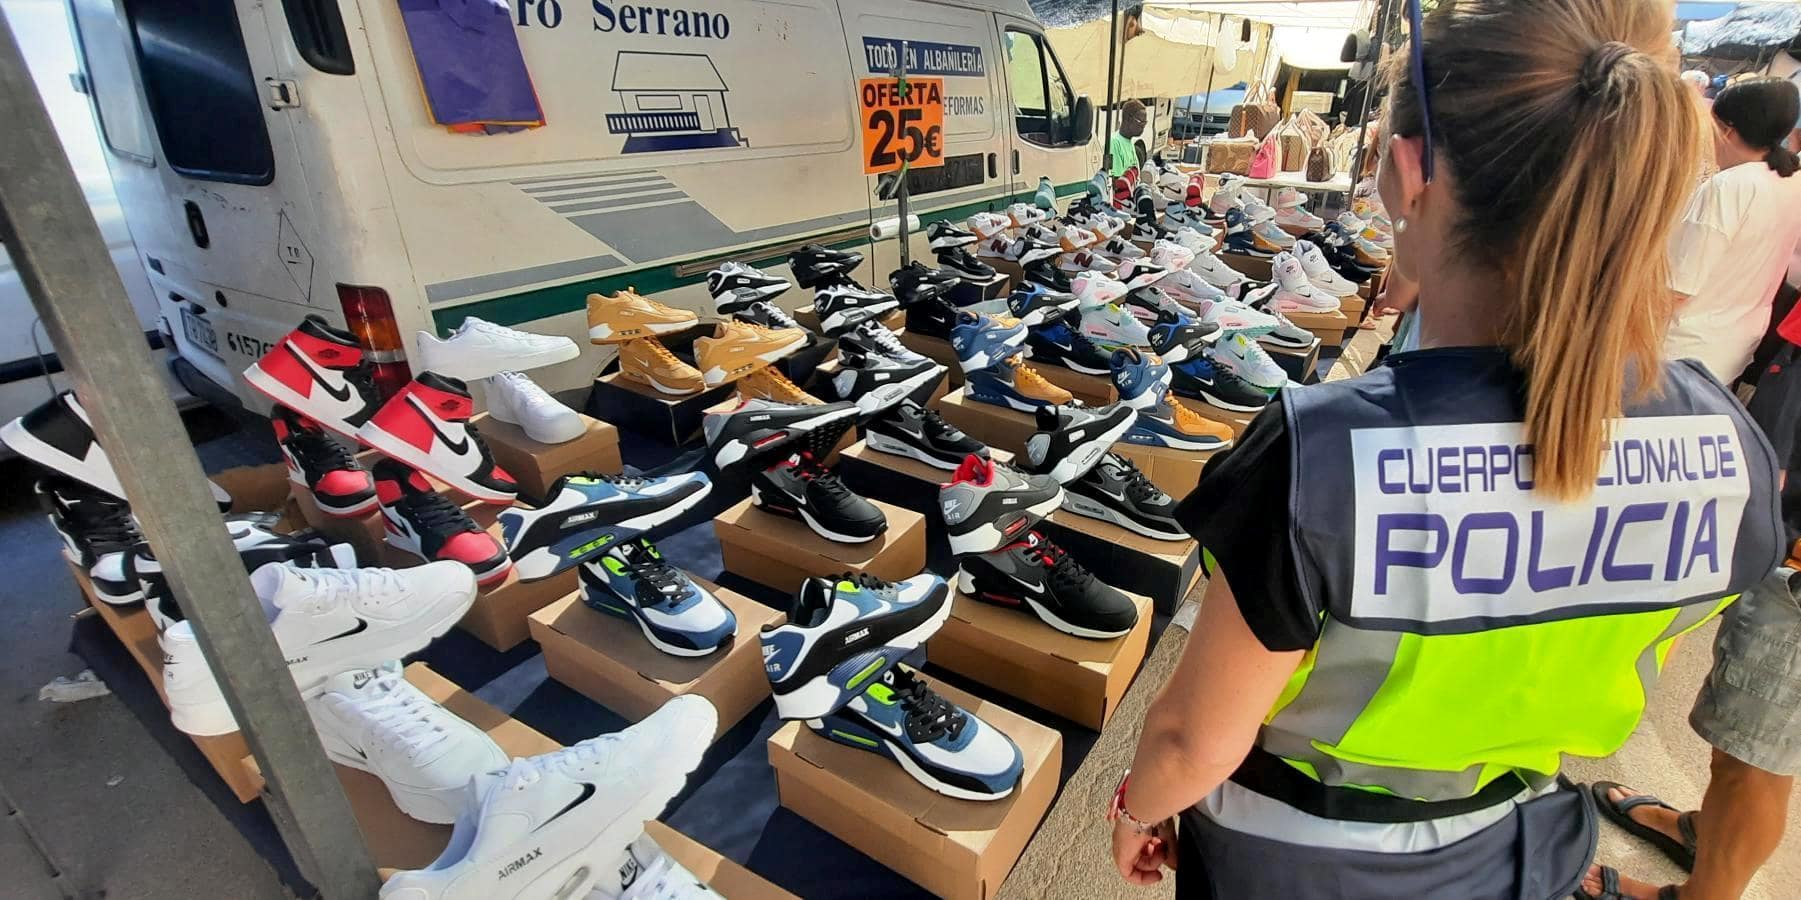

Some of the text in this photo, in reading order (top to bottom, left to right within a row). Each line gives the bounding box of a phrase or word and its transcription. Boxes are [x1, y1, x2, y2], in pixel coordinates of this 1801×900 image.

[517, 0, 730, 39] ro Serrano
[923, 46, 984, 73] ALBAÑILERÍA
[863, 83, 942, 107] OFERTA
[944, 96, 984, 116] EFORMAS
[868, 108, 942, 168] 25€
[1378, 444, 1536, 495] CUERPO
[1699, 435, 1737, 480] DE
[1374, 497, 1720, 595] POLICIA
[498, 847, 543, 880] AIRMAX
[618, 858, 636, 882] NIKE
